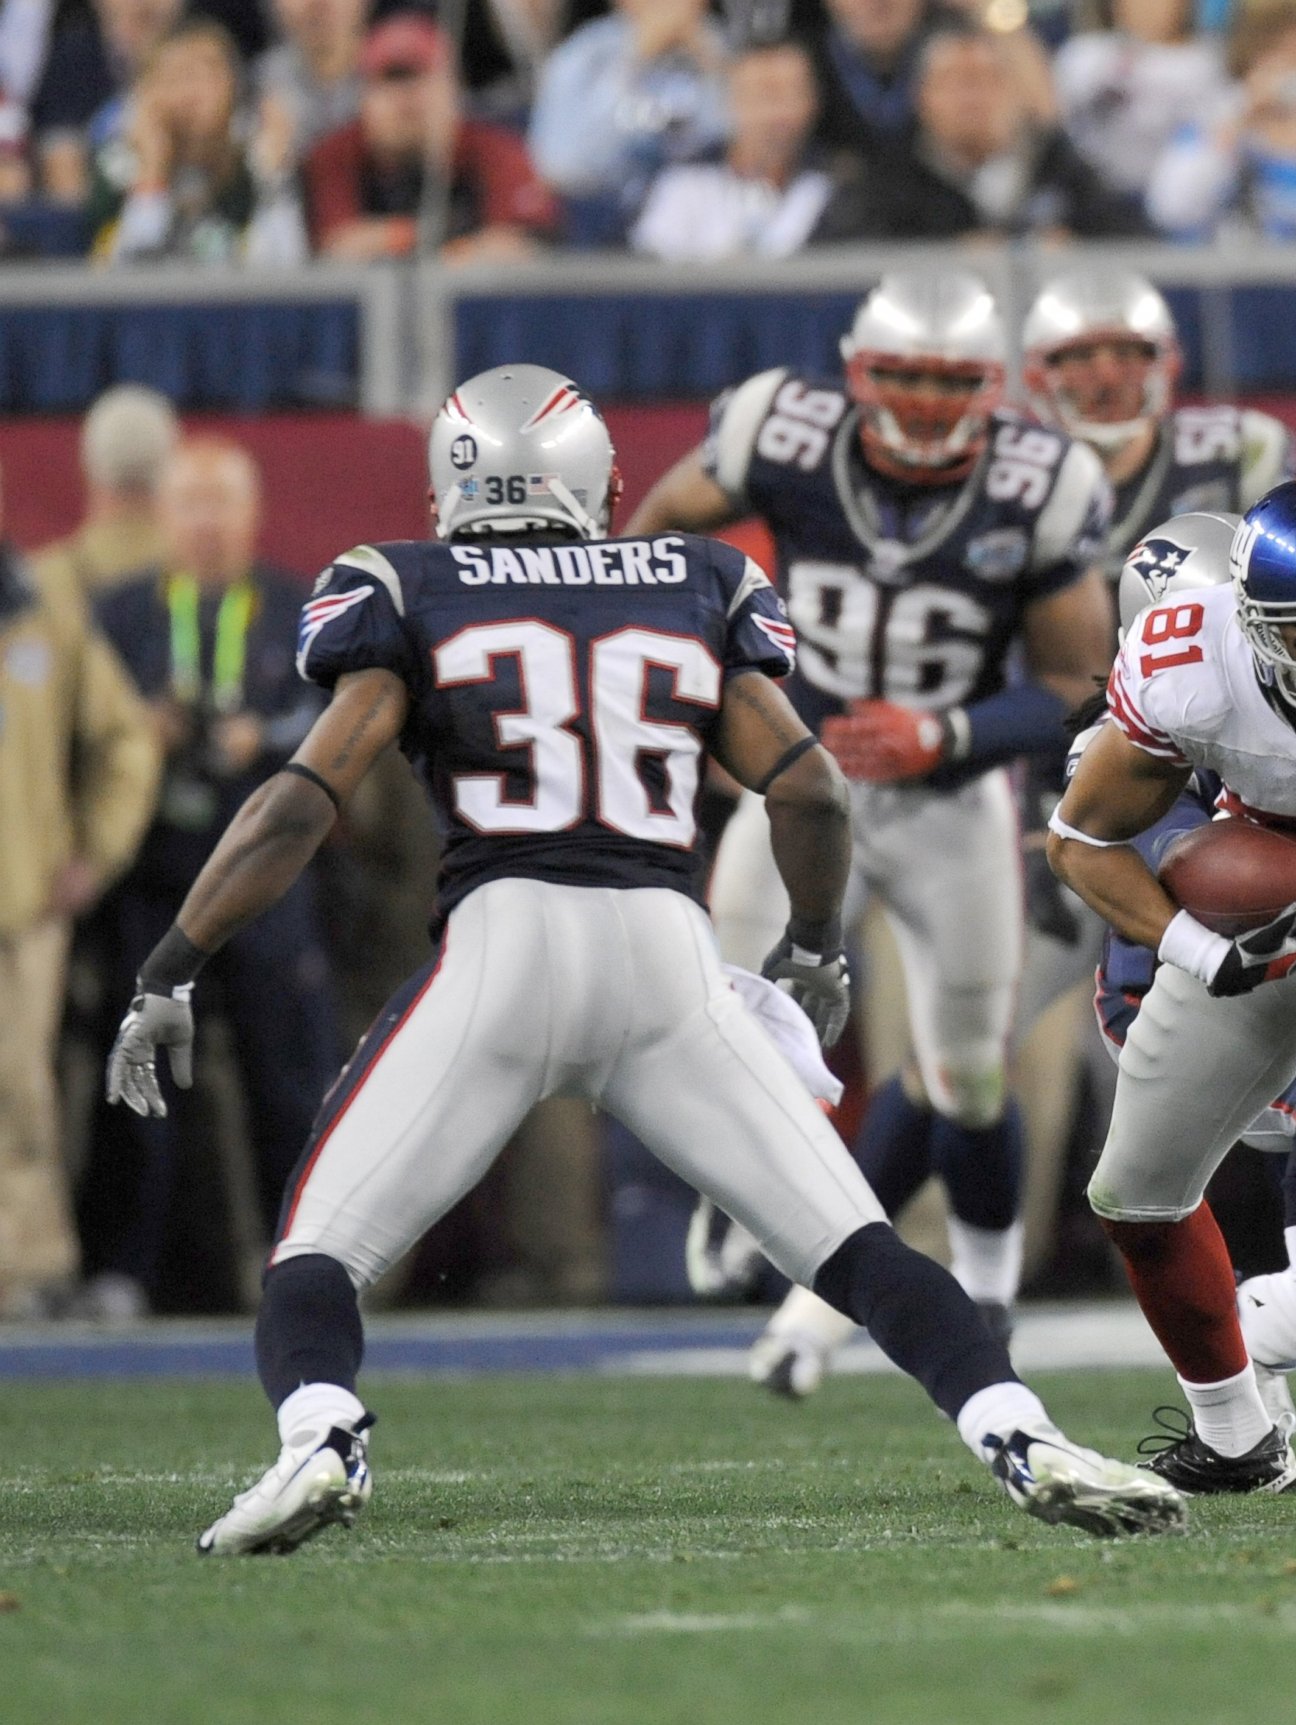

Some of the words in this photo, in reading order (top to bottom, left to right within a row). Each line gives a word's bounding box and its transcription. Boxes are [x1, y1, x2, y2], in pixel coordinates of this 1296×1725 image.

[451, 439, 475, 465] 91
[484, 475, 527, 505] 36
[449, 536, 688, 586] SANDERS
[787, 559, 993, 711] 96
[1139, 602, 1205, 680] 81
[432, 615, 725, 854] 36
